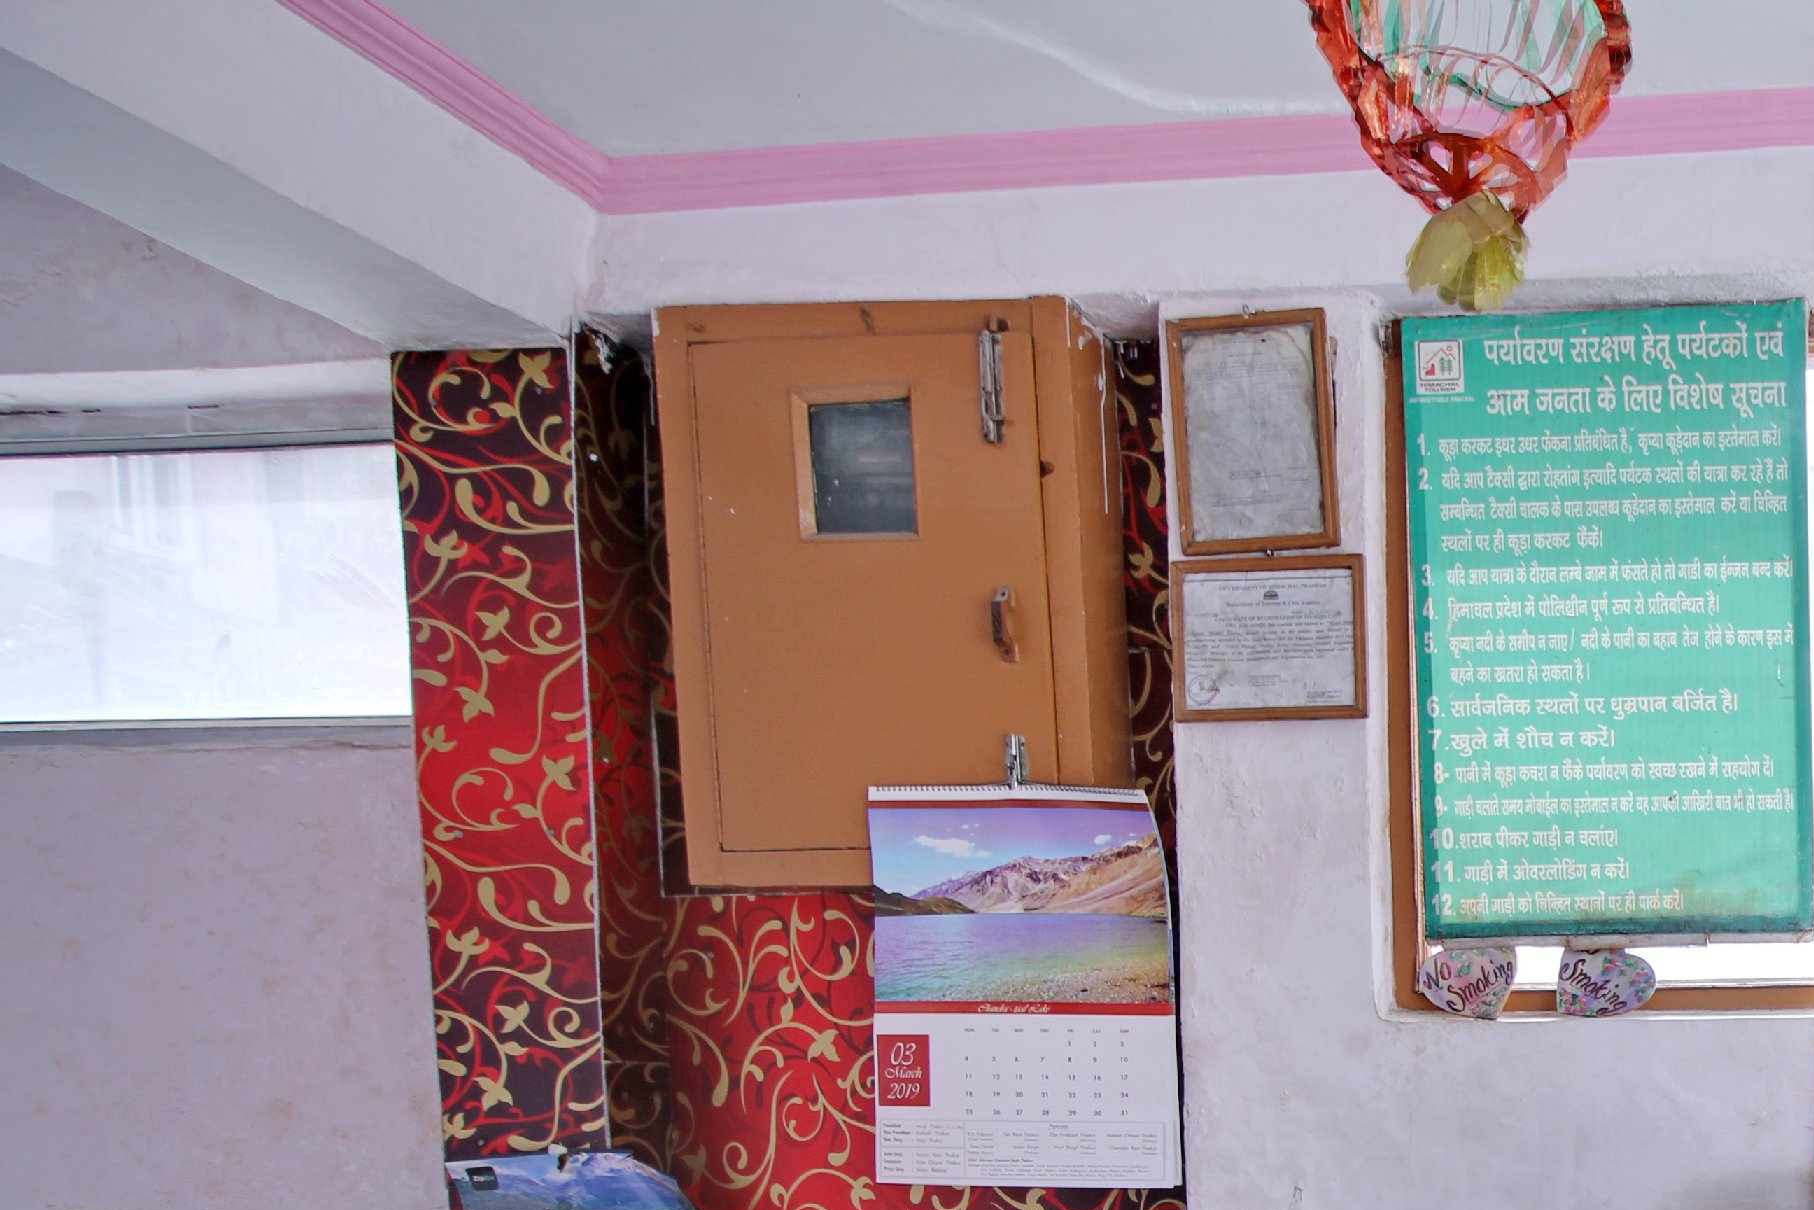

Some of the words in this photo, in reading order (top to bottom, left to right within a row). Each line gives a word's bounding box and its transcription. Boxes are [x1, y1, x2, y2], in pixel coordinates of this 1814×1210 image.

[1483, 326, 1564, 365] पर्यावरण
[1570, 328, 1636, 364] संरक्षण
[1642, 323, 1677, 370] हेतू
[1677, 320, 1748, 360] पर्यटकों
[1755, 322, 1784, 360] एवं
[1487, 388, 1530, 415] आम
[1535, 387, 1591, 414] जनता
[1597, 376, 1617, 412] के
[1622, 376, 1662, 413] लिए
[1668, 372, 1724, 410] विशेष
[1730, 381, 1787, 418] सूचना
[1461, 437, 1493, 455] करकट
[1495, 436, 1516, 457] इधर
[1518, 436, 1538, 454] उधर
[1703, 431, 1715, 449] का
[1718, 424, 1759, 451] इस्तेमाल
[1447, 597, 1493, 621] हिमाचल
[1496, 595, 1522, 620] प्रदेश
[1524, 594, 1536, 617] में
[1591, 592, 1608, 622] पूर्ण
[1612, 599, 1631, 615] रूप
[1635, 592, 1645, 615] से
[1450, 692, 1531, 718] सार्वजनिक
[1535, 691, 1579, 716] स्थलों
[1584, 698, 1606, 715] पर
[1493, 726, 1510, 749] में
[1516, 725, 1554, 749] शौच
[1559, 731, 1575, 748] न
[1495, 825, 1530, 848] पीकर
[1564, 829, 1576, 847] न
[1497, 859, 1509, 881] में
[1513, 857, 1587, 881] ओवरलोडिंग
[1590, 863, 1602, 880] न
[1518, 891, 1533, 913] को
[1608, 896, 1622, 913] पर
[1625, 890, 1636, 914] ही
[1423, 958, 1451, 992] No
[1446, 959, 1515, 1012] Smoking
[1559, 958, 1628, 1016] Smoking
[890, 1043, 917, 1065] 03
[885, 1066, 922, 1079] March
[887, 1083, 920, 1099] 2019
